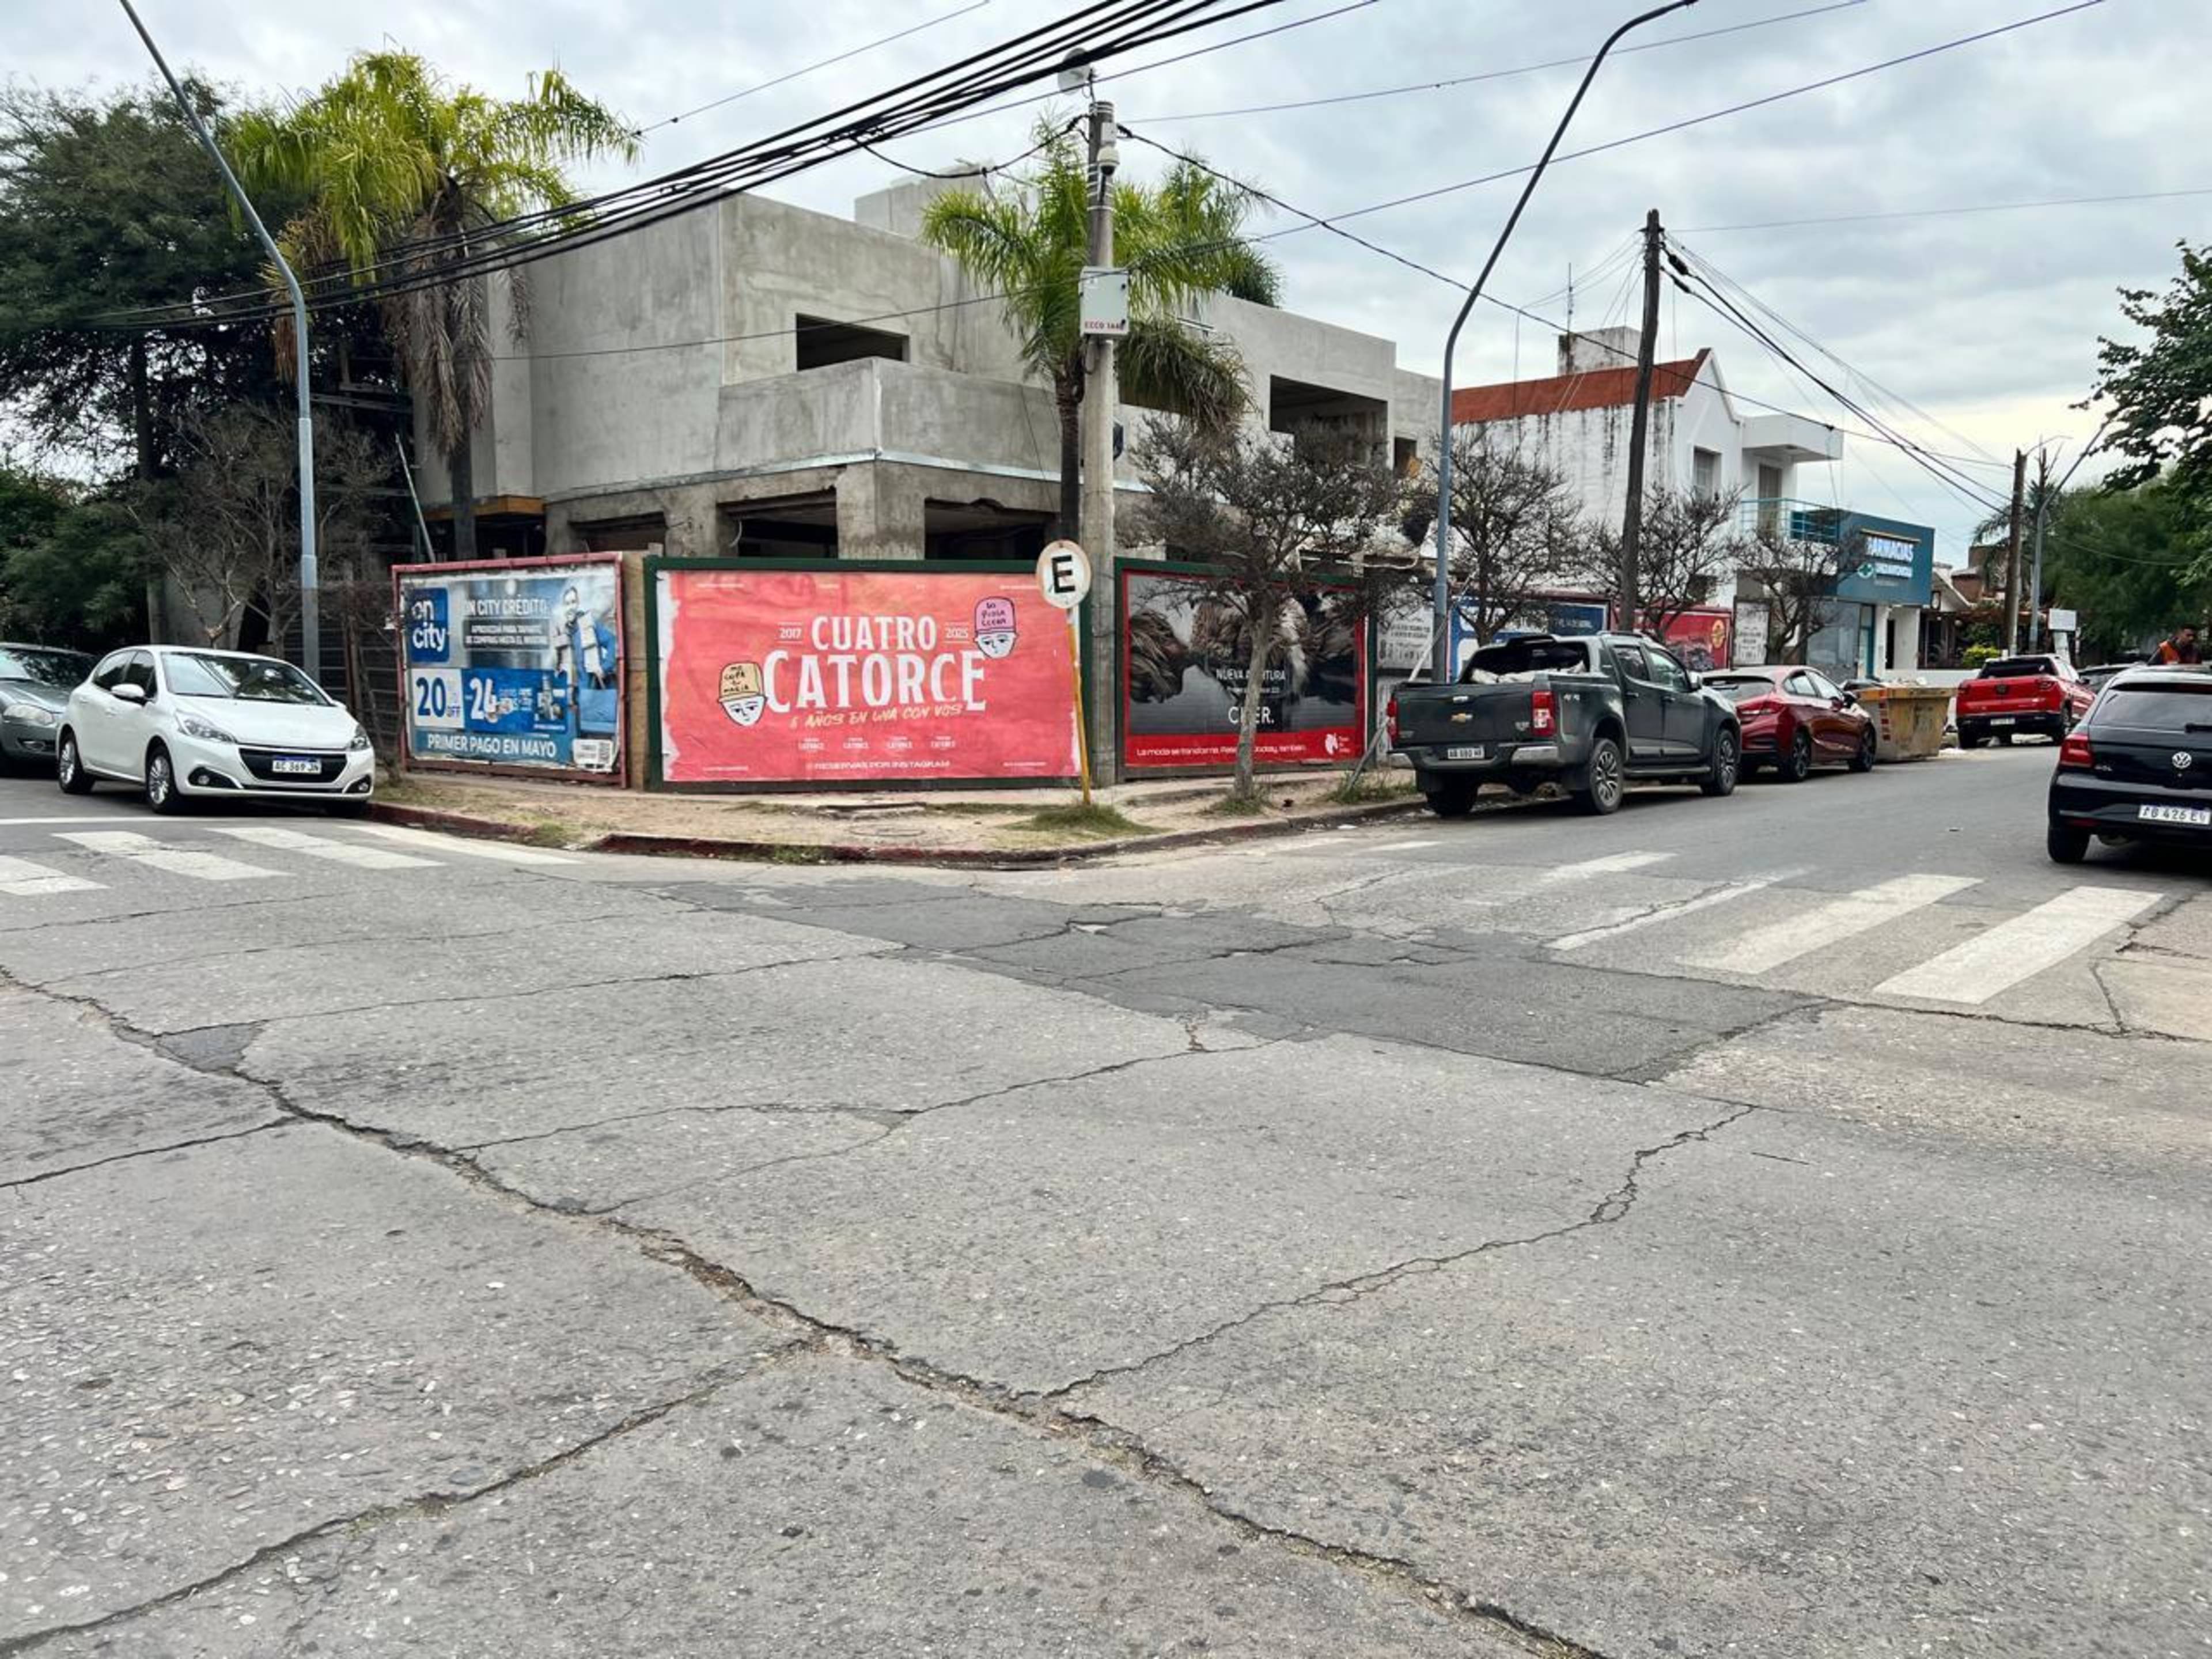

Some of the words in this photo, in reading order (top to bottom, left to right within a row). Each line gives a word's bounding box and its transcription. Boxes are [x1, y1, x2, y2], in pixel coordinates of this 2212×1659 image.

[1051, 555, 1075, 593] E
[478, 599, 501, 615] CITY
[412, 622, 446, 652] city
[779, 628, 802, 639] 2017
[811, 615, 937, 650] CUATRO
[762, 649, 986, 713] CATORCE
[1216, 669, 1243, 680] NUEVA
[416, 677, 446, 718] 20
[805, 711, 844, 728] AÑOS
[849, 713, 868, 725] EN
[872, 710, 897, 722] UNA
[902, 707, 929, 719] CON
[934, 704, 963, 717] VOS
[428, 734, 469, 751] PRIMER
[469, 737, 500, 753] PAGO
[503, 740, 520, 754] EN
[522, 741, 556, 757] MAYO
